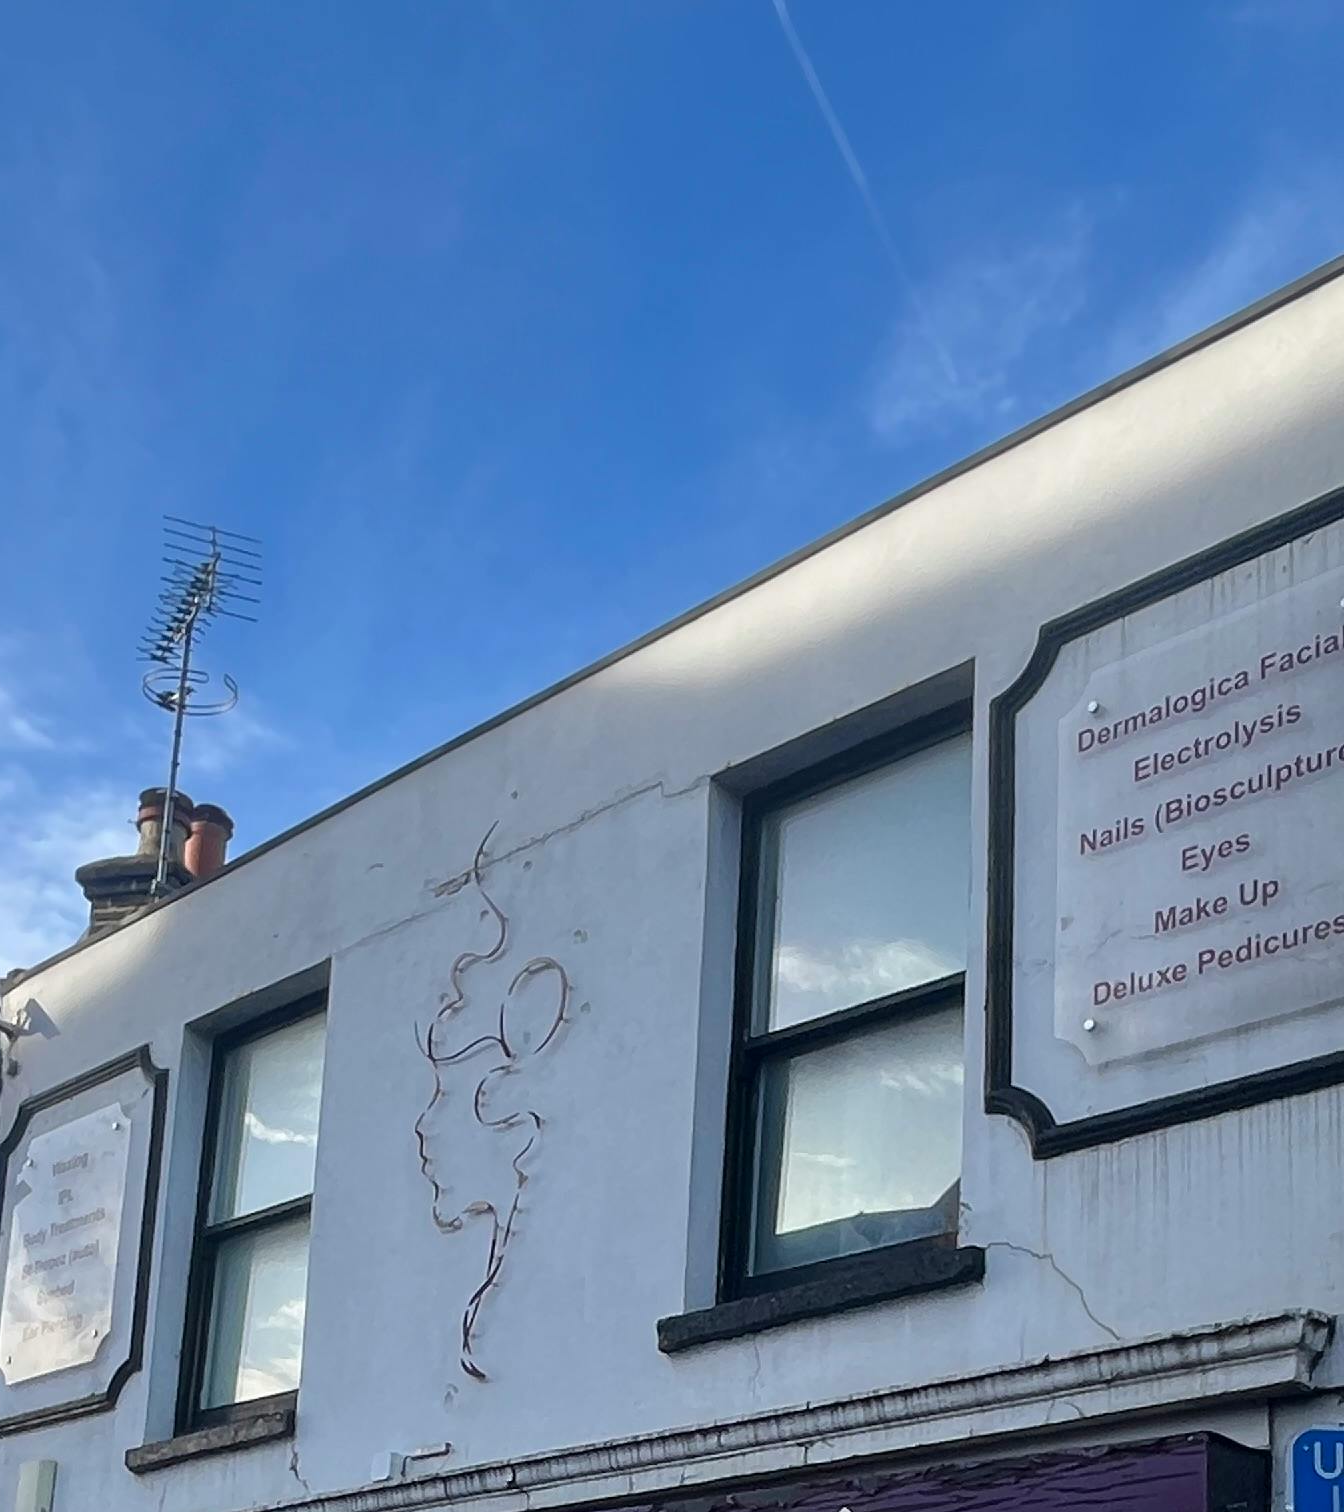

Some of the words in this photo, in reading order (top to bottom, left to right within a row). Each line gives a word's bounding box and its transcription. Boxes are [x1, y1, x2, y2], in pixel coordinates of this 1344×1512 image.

[1077, 668, 1250, 752] Dermalogica
[1134, 703, 1302, 782] Electrolysis
[1080, 814, 1145, 855] Nails
[1181, 832, 1251, 872] Eyes
[1154, 895, 1228, 934] Make
[1239, 877, 1279, 909] Up
[1092, 961, 1187, 1006] Deluxe
